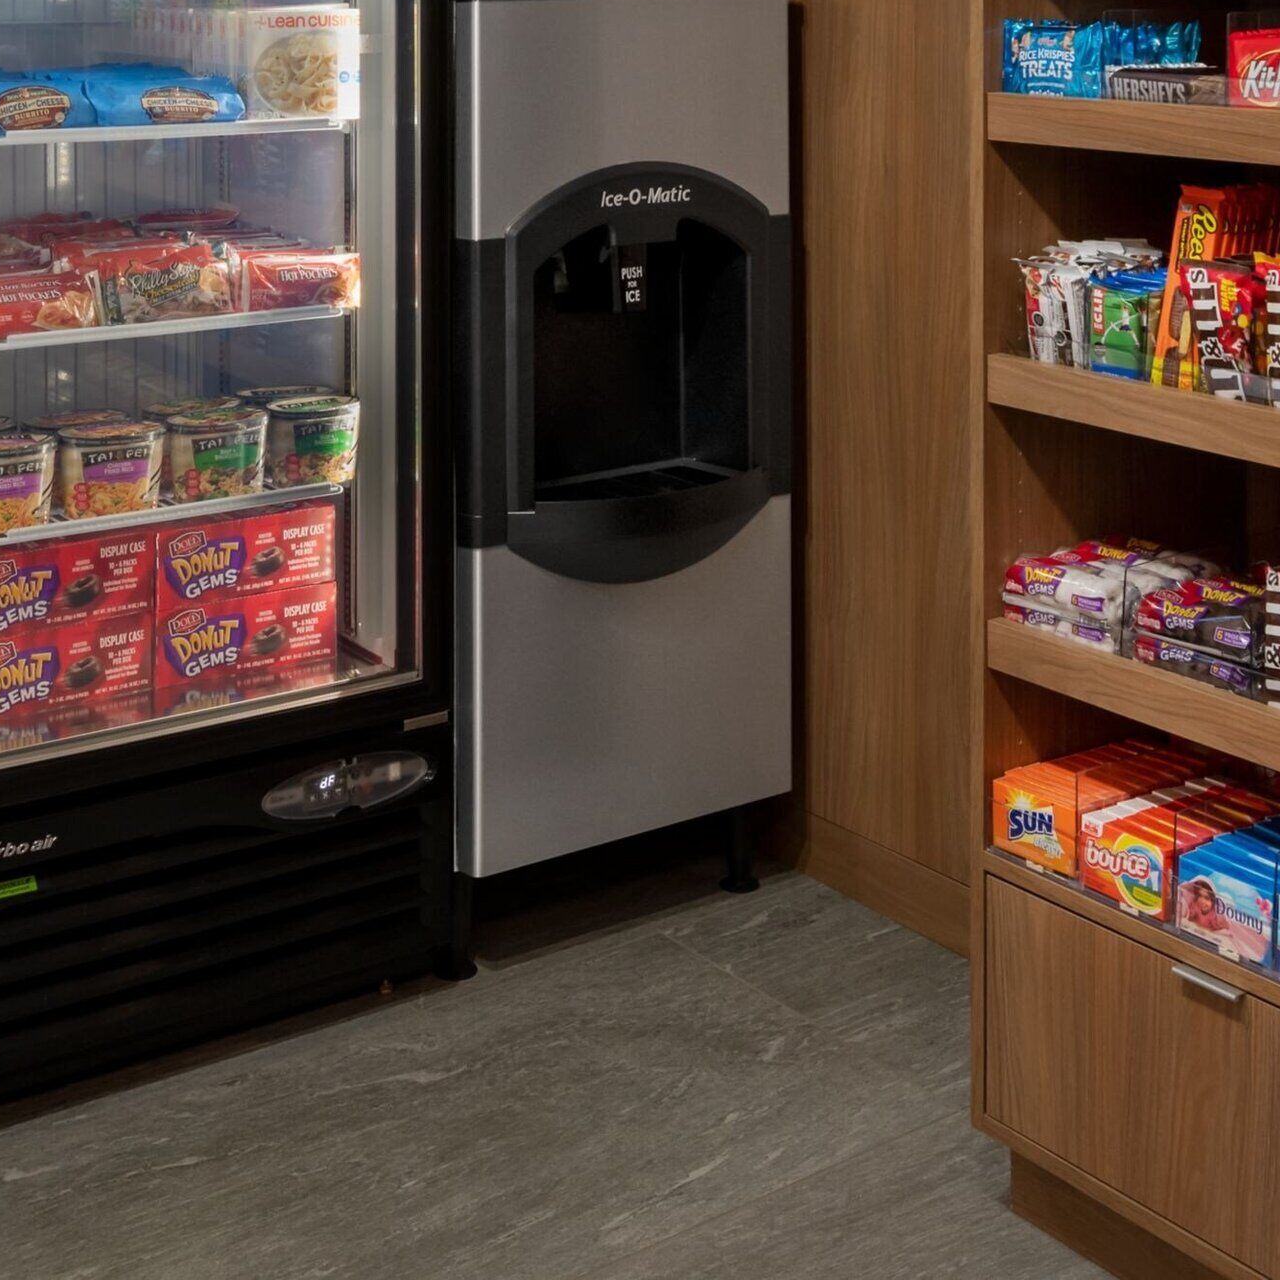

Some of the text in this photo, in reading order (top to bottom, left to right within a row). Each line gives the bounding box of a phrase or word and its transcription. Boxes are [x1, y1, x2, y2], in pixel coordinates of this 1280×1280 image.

[1019, 48, 1075, 61] RICE KRISPIES
[1020, 61, 1073, 80] TREATS
[1113, 77, 1186, 104] HERSHEY'S
[35, 96, 65, 107] CHEESE
[600, 185, 691, 207] Ice-O-Matic
[621, 266, 643, 280] PUSH
[625, 290, 641, 303] ICE
[199, 439, 222, 450] TAI
[89, 448, 148, 463] TAI PEI
[18, 463, 43, 473] PEI
[283, 523, 325, 540] DISPLAY CASE
[100, 541, 146, 558] DISPLAY CASE
[172, 542, 239, 585] DONUT
[186, 569, 238, 598] GEMS
[1027, 583, 1055, 596] GEMS
[284, 601, 327, 618] DISPLAY CASE
[1165, 618, 1195, 630] GEMS
[100, 630, 145, 648] DISPLAY CASE
[171, 620, 239, 663] DONUT
[186, 647, 238, 677] GEMS
[1009, 807, 1053, 840] SUN
[31, 834, 58, 851] air
[1086, 839, 1150, 879] bounce
[1215, 897, 1264, 934] Downy
